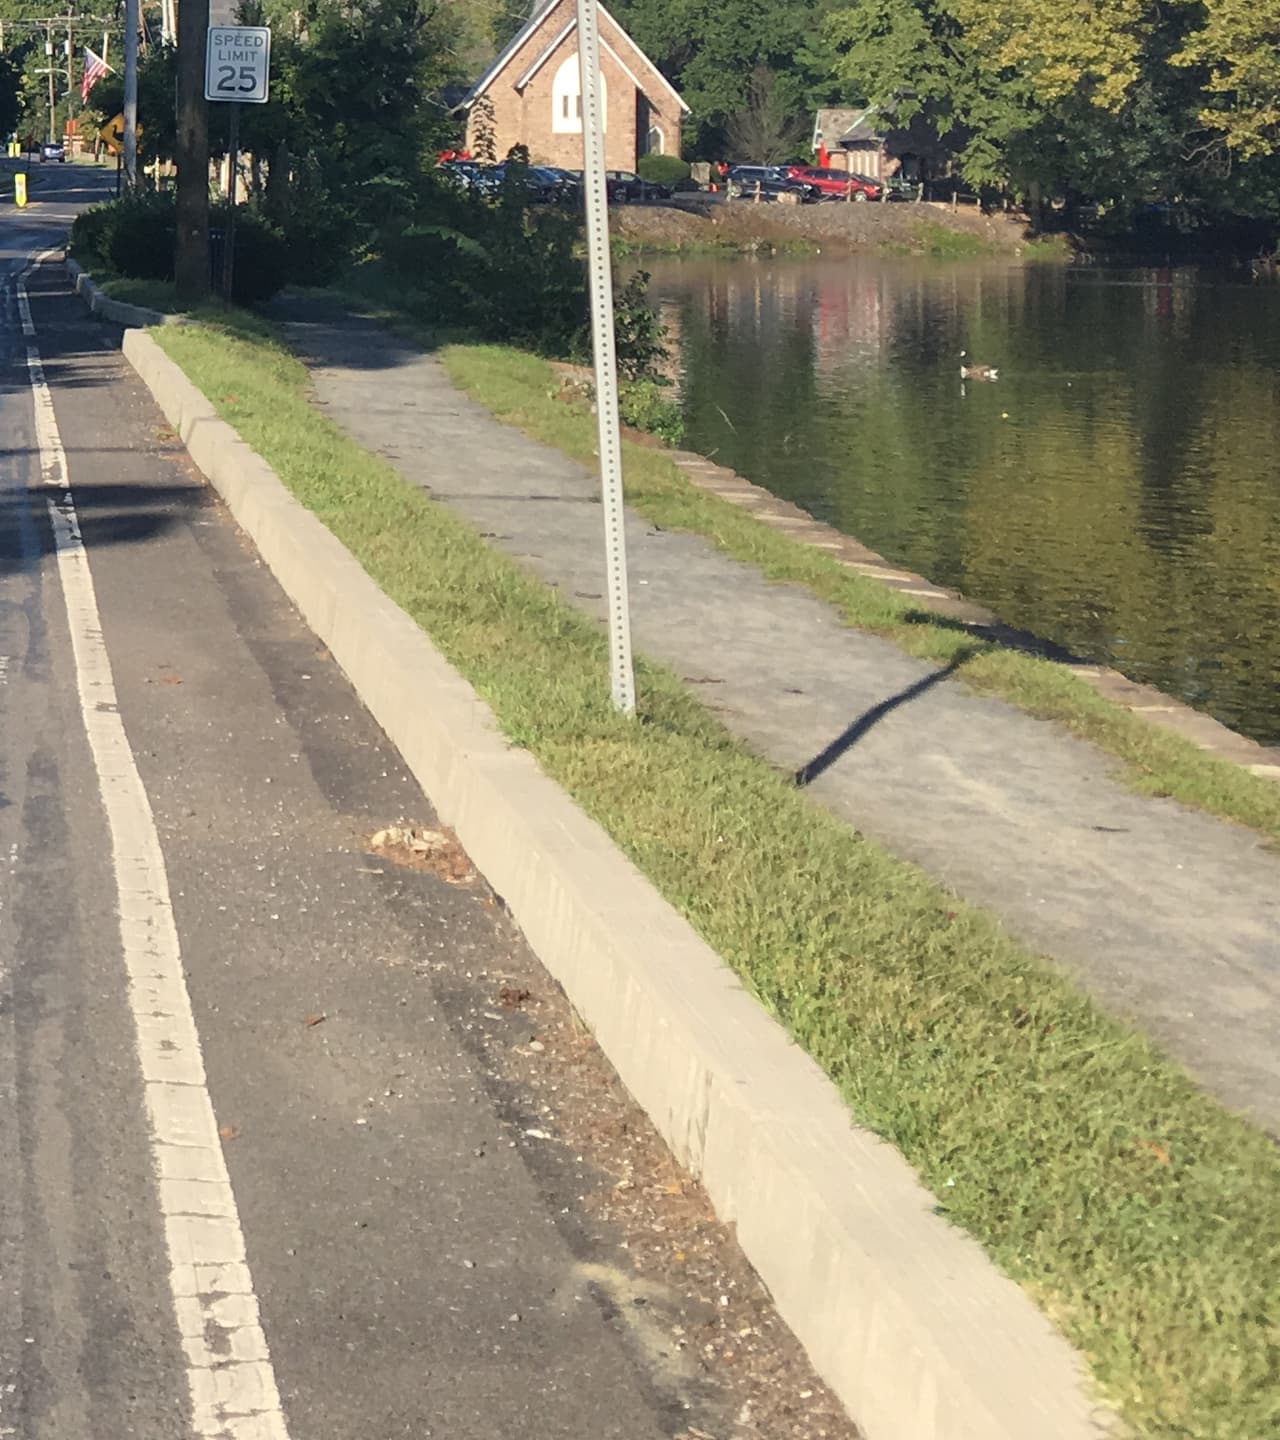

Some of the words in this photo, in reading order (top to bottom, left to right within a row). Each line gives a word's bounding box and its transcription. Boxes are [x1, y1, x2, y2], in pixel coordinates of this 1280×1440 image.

[214, 34, 264, 48] SPEED
[218, 50, 258, 62] LIMIT
[217, 65, 257, 93] 25
